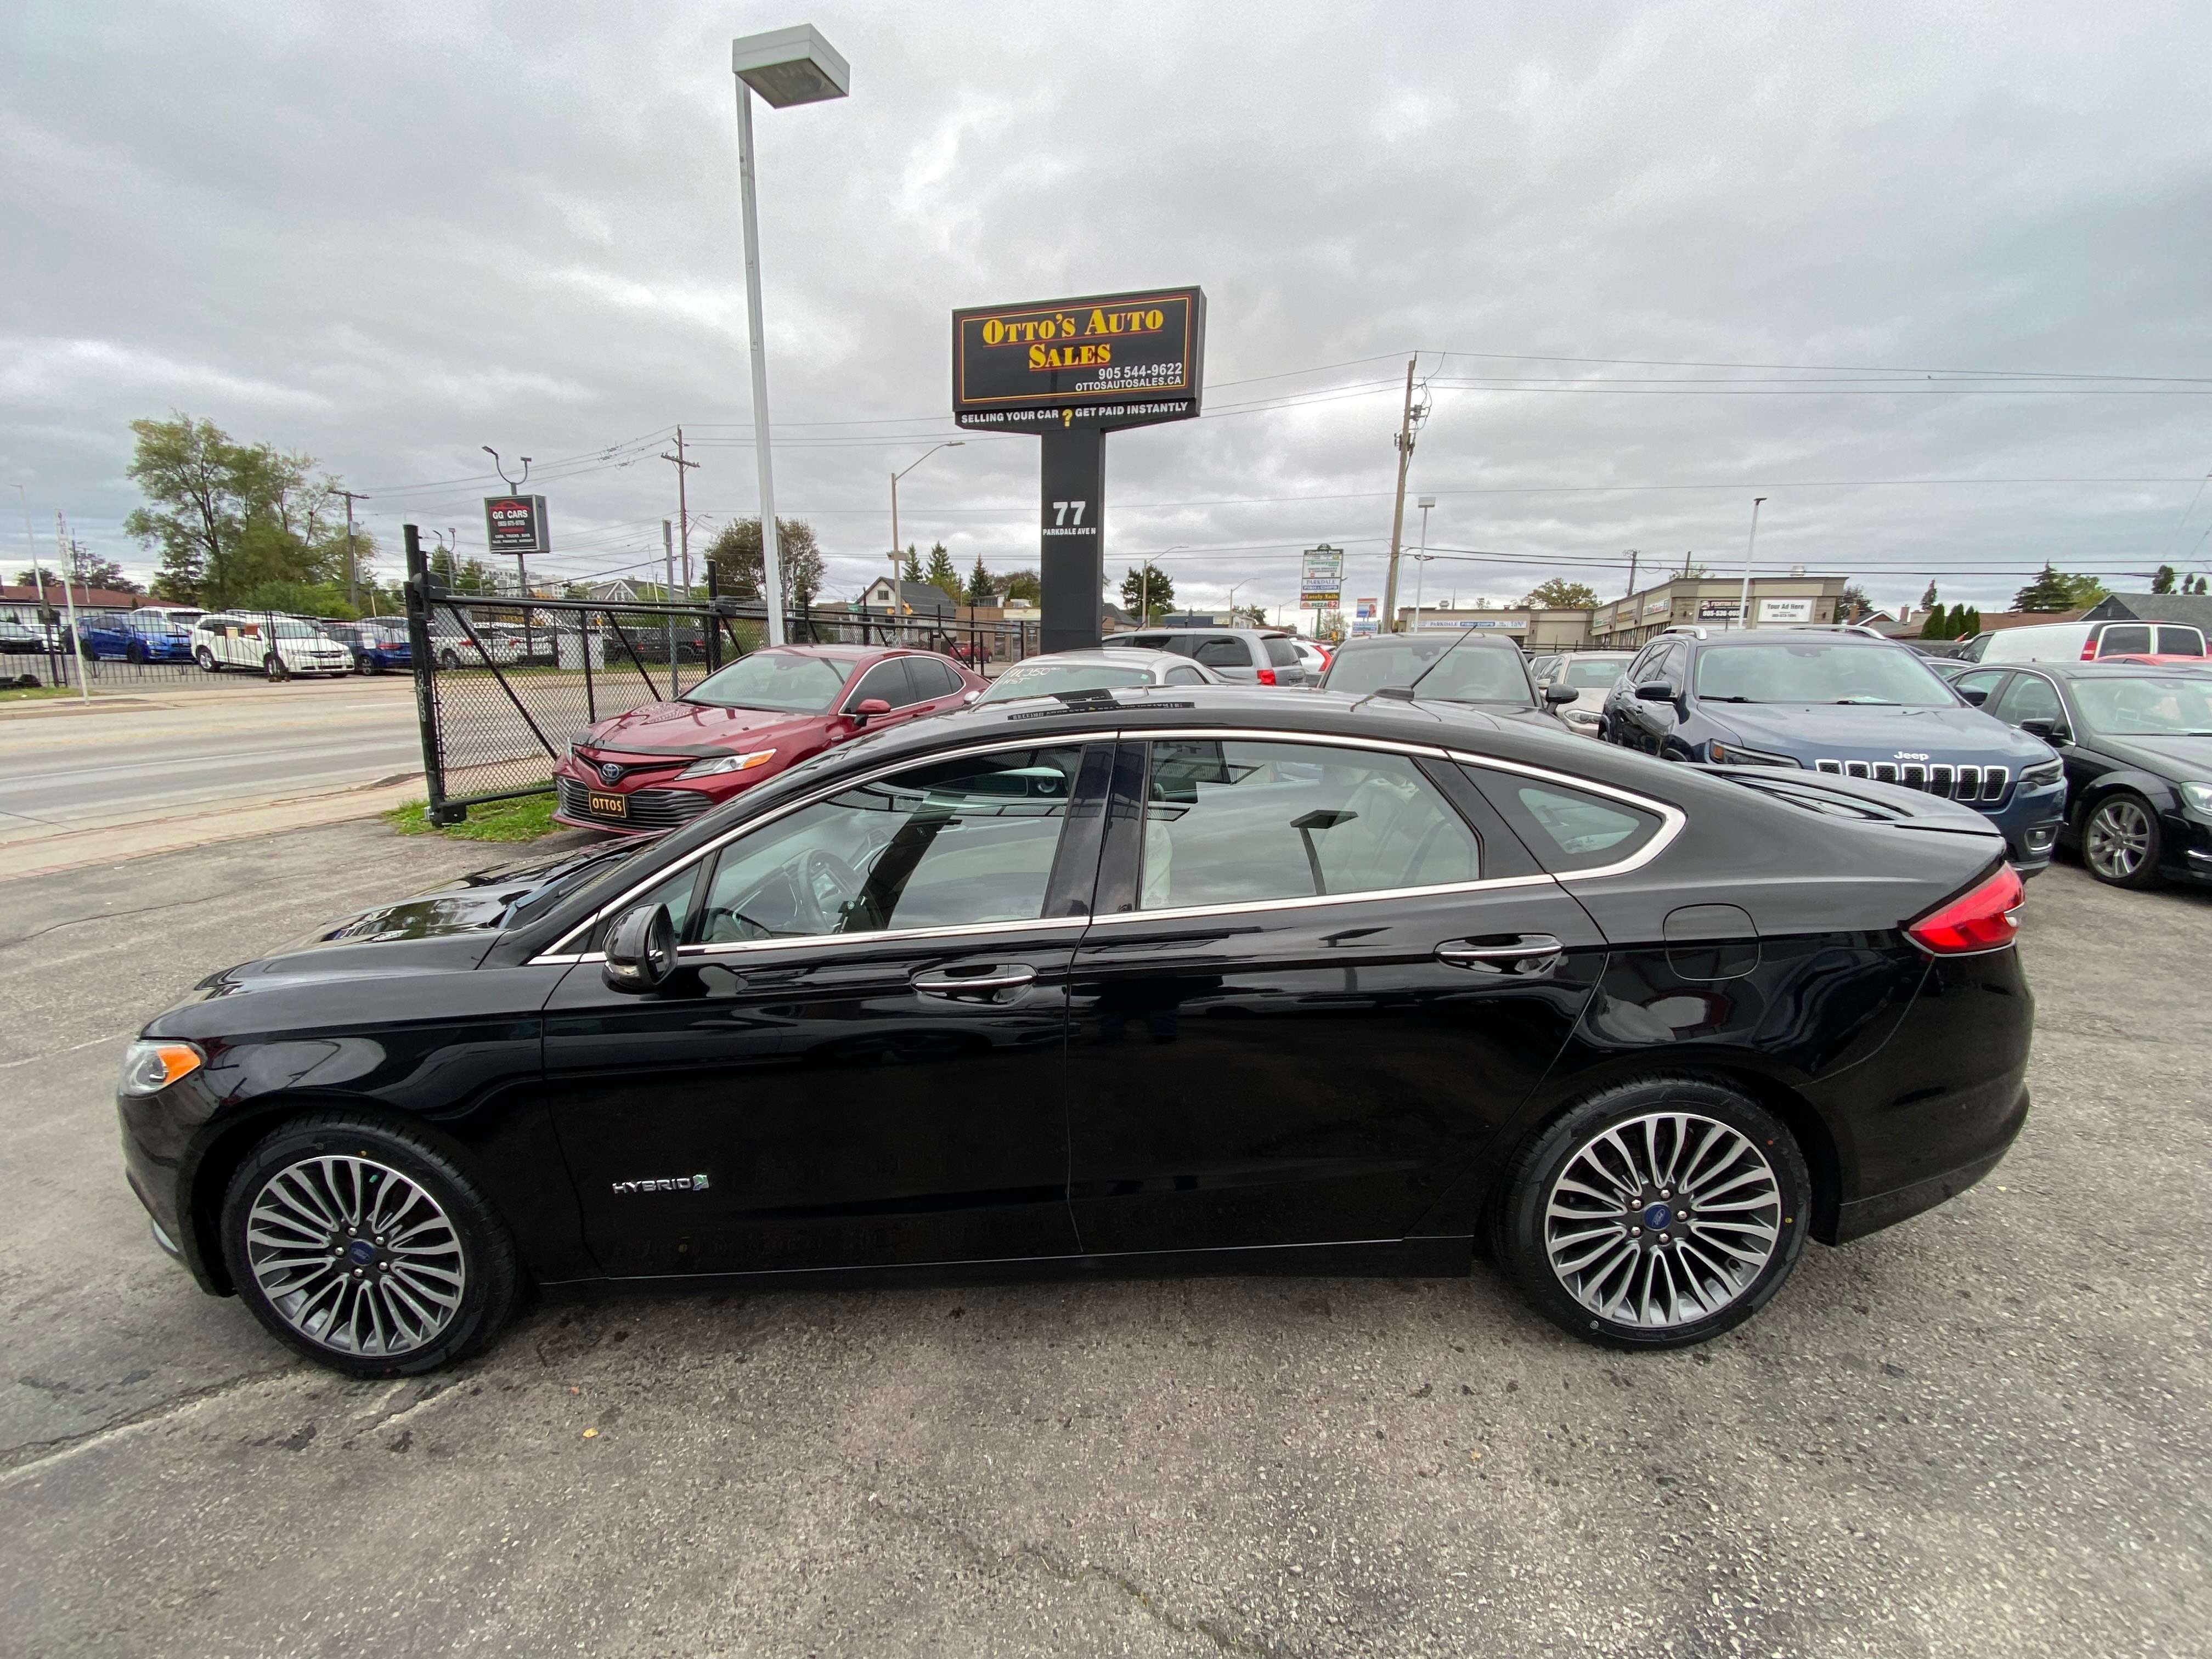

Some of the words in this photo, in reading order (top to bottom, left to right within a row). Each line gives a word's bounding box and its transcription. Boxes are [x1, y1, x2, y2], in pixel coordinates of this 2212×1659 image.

[1098, 367, 1120, 380] 905
[1124, 362, 1182, 378] 544-9622
[1075, 376, 1181, 391] OTTOSAUTOSALES.CA
[961, 413, 1005, 424] SELLING
[1006, 411, 1035, 421] YOUR
[1037, 409, 1059, 419] CAR
[1075, 407, 1097, 417] GET
[1098, 405, 1125, 416] PAID
[1127, 402, 1188, 415] INSTANTLY
[492, 511, 504, 520] GG
[507, 510, 528, 519] CARS
[1053, 501, 1086, 526] 77
[1893, 751, 1929, 761] Jeep
[592, 798, 622, 811] OTTOS
[612, 1178, 691, 1194] HYBRID
